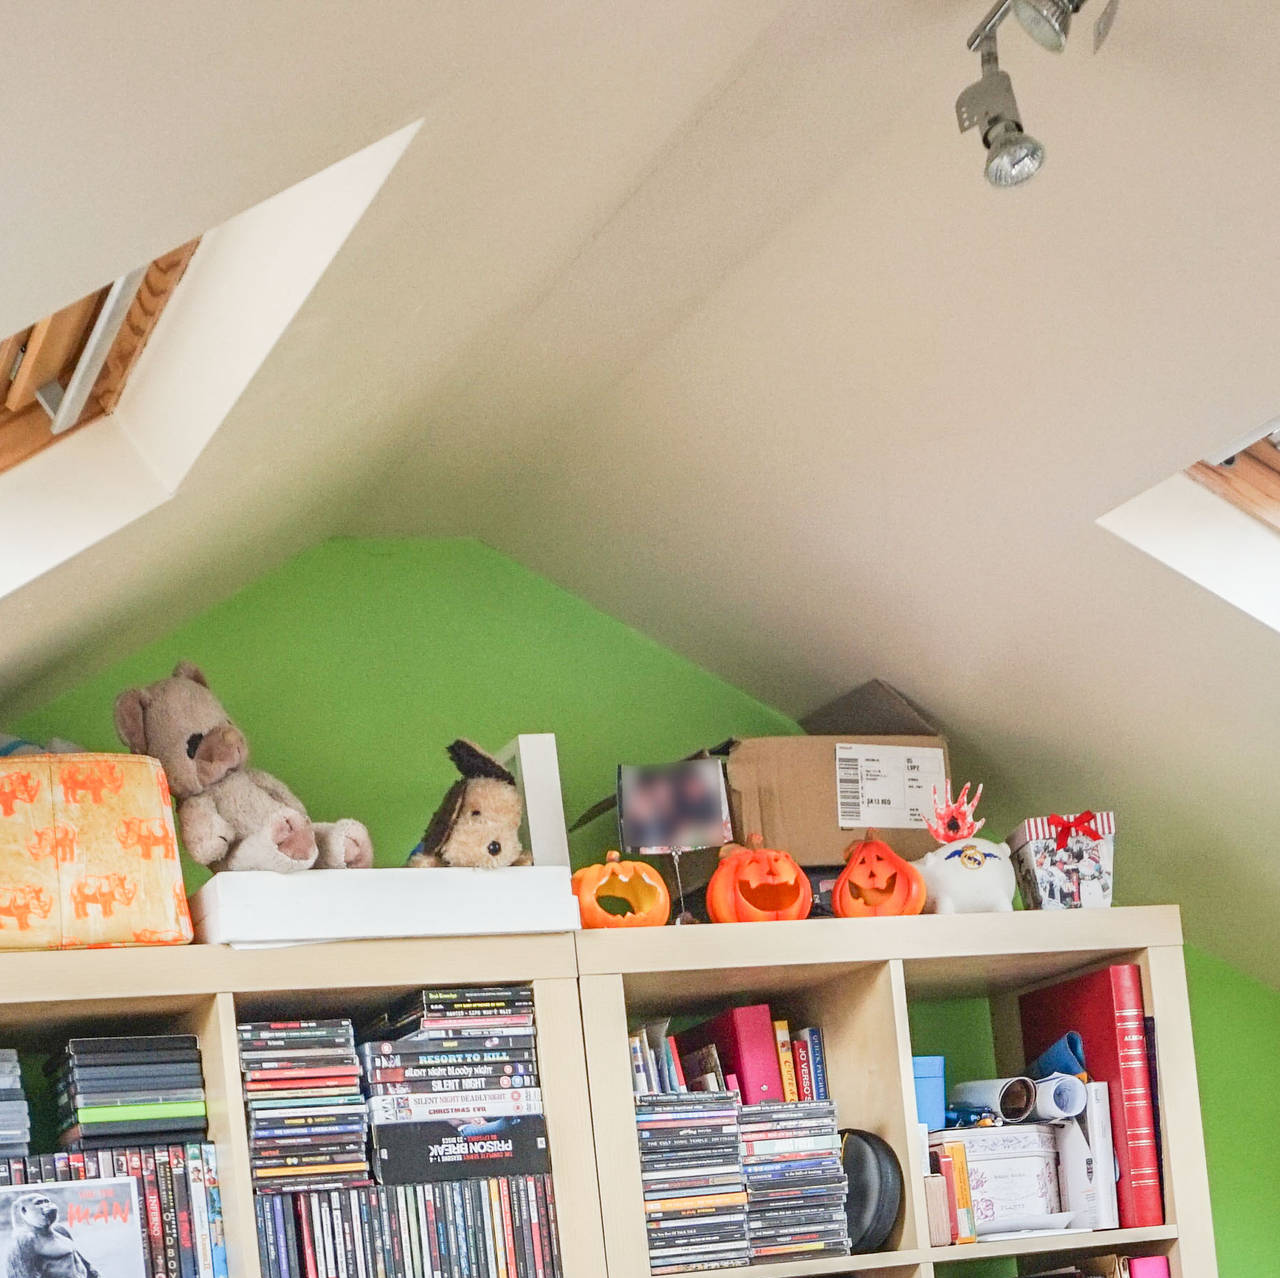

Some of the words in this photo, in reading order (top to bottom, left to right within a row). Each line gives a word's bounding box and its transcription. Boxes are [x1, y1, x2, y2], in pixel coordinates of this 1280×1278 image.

[419, 1052, 464, 1066] RESORT
[465, 1053, 481, 1062] TO
[483, 1050, 509, 1062] KILL
[799, 1048, 806, 1060] JO
[432, 1079, 460, 1091] SILENT
[461, 1077, 487, 1090] NIGHT
[801, 1062, 811, 1101] VERSO'S
[413, 1097, 438, 1106] SILENT
[439, 1096, 459, 1104] NIGHT
[428, 1106, 470, 1116] CHRISTMAS
[428, 1143, 468, 1156] BREAK
[469, 1140, 513, 1153] PRISON
[67, 1200, 131, 1228] MAN
[148, 1195, 161, 1236] INFERNO
